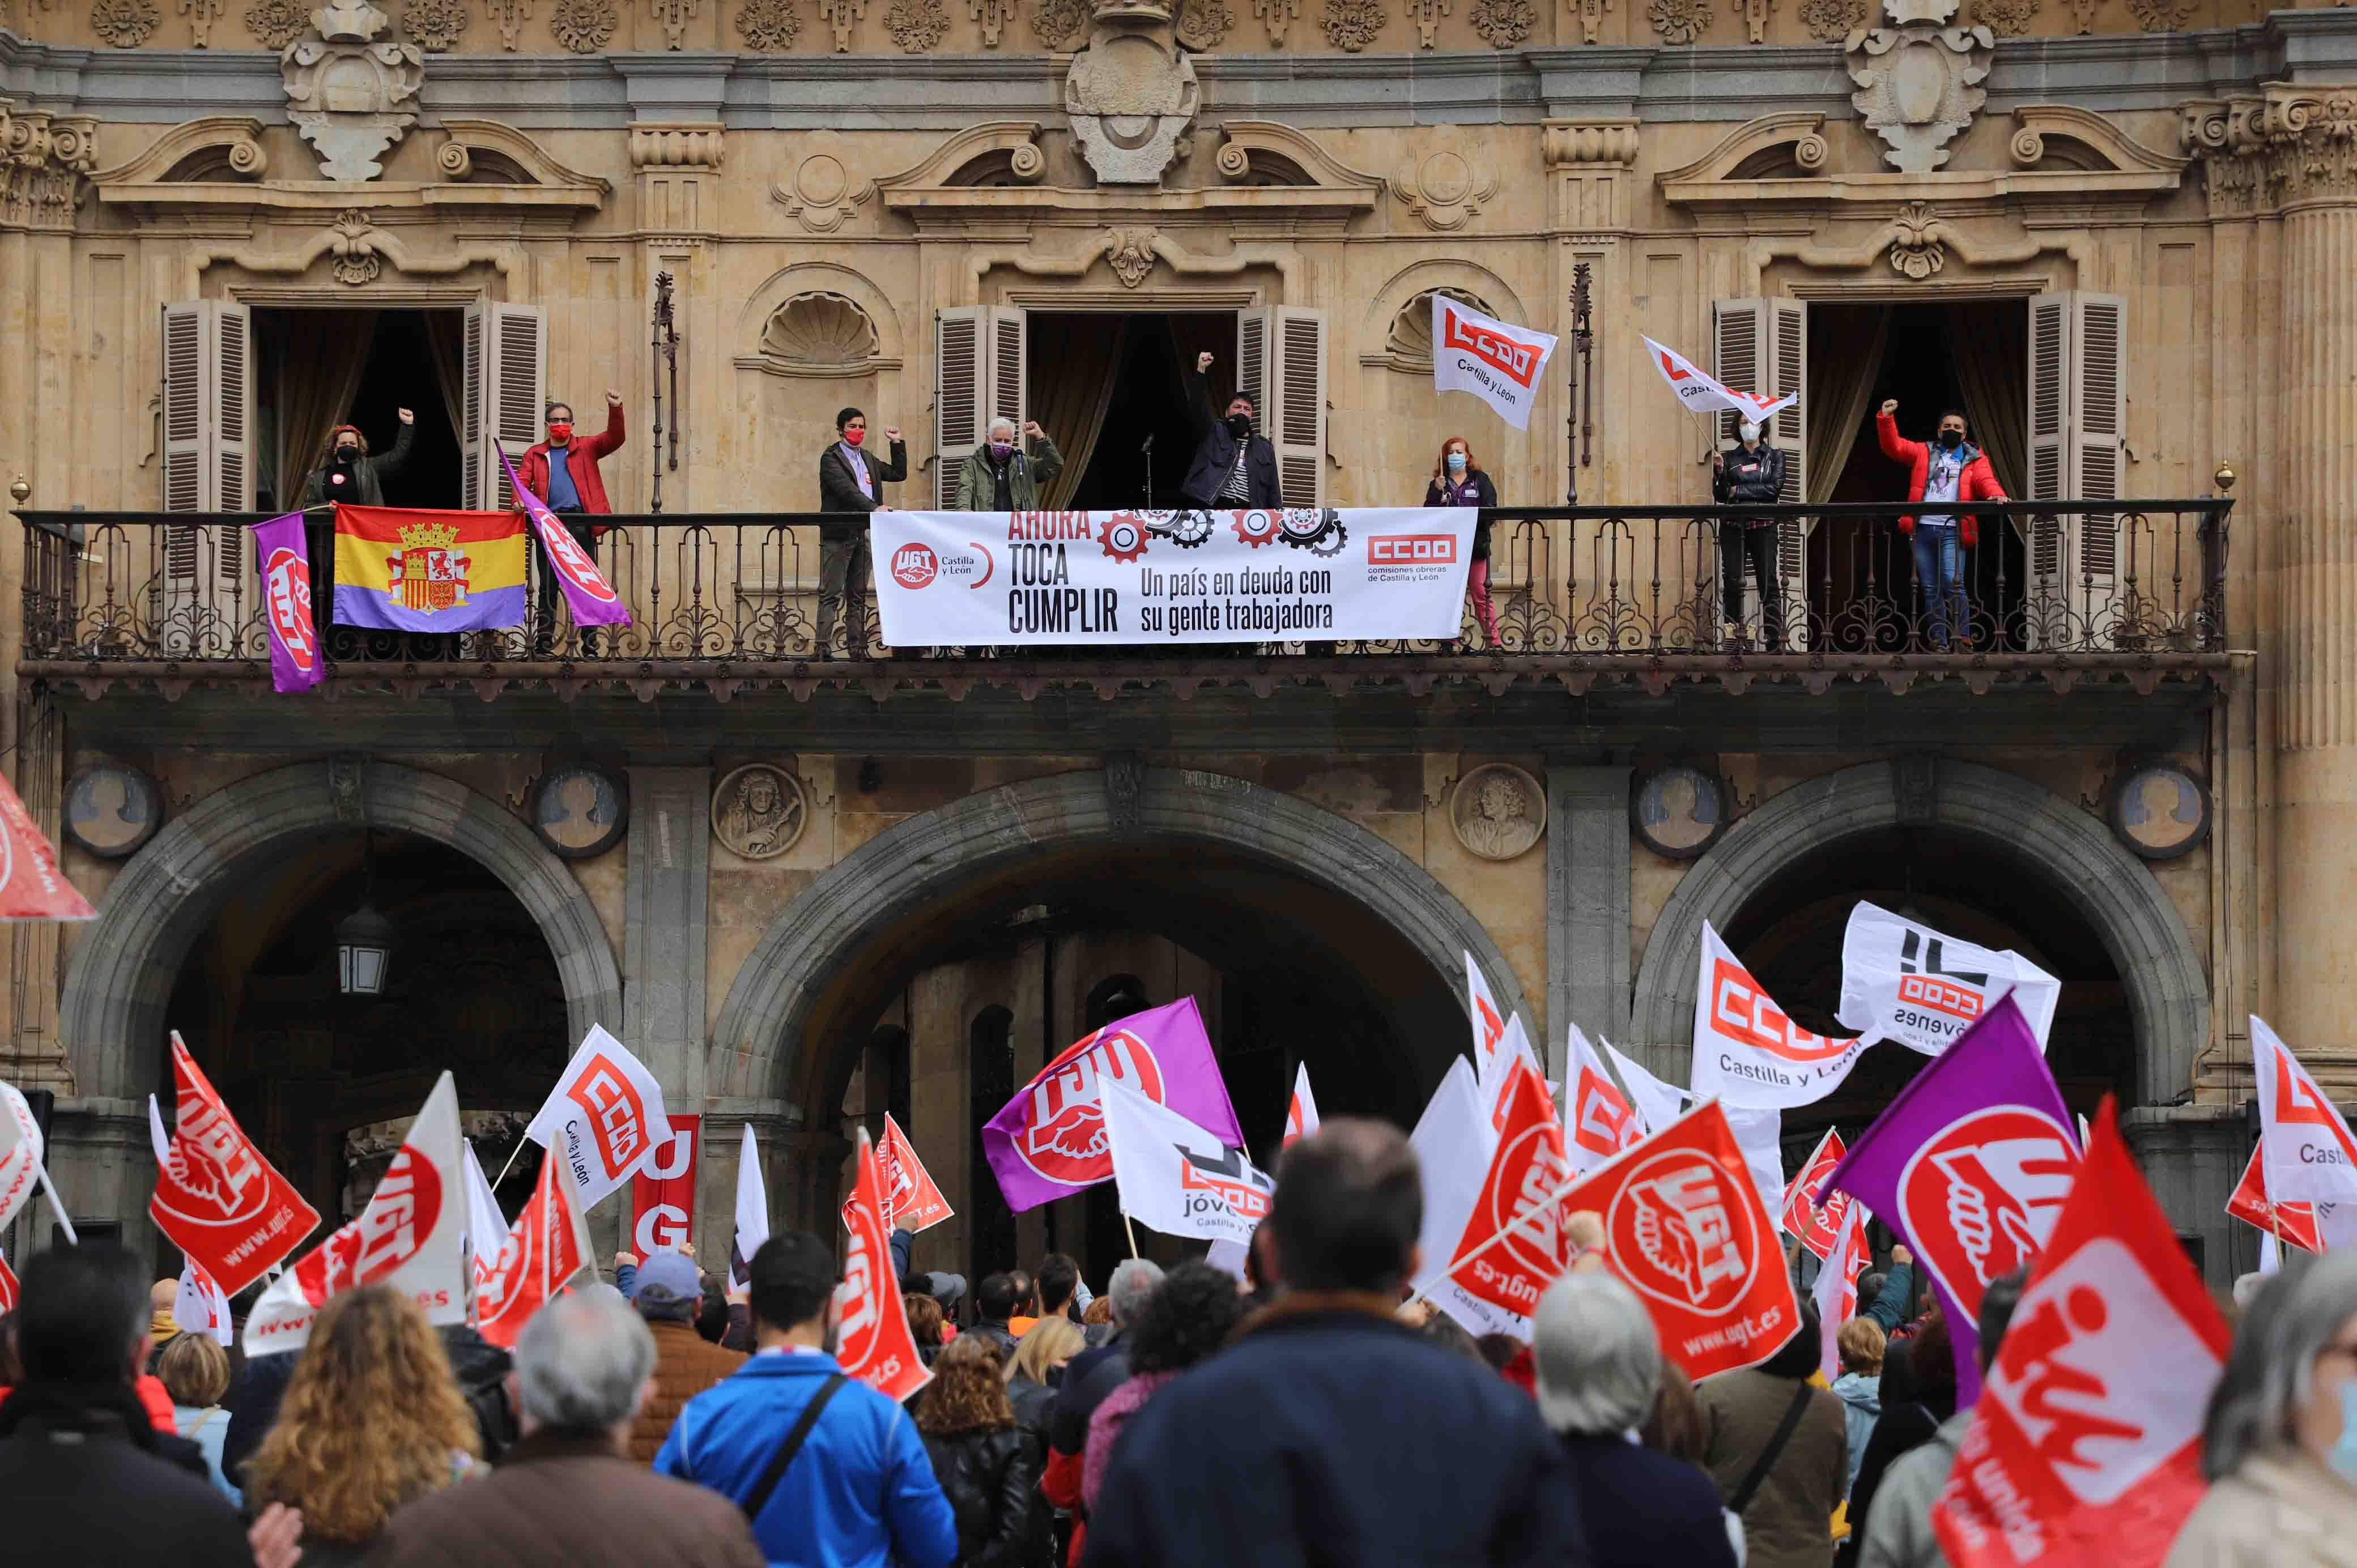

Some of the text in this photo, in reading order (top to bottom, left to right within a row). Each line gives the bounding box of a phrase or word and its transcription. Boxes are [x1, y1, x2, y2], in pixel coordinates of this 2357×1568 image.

[1454, 316, 1532, 377] CCOO
[1457, 359, 1516, 404] Catilla y León
[1008, 510, 1091, 540] AHORA
[896, 551, 931, 569] UGT
[942, 556, 974, 565] Castilla
[1009, 543, 1069, 586] TOCA
[1373, 540, 1451, 559] CCOO
[950, 566, 971, 574] León
[1141, 564, 1331, 600] Un país en deuda con
[1009, 587, 1118, 633] CUMPLIR
[1141, 598, 1333, 636] su gente trabajadora
[1717, 977, 1850, 1051] CCO
[1720, 1054, 1790, 1086] Castilla
[1797, 1073, 1809, 1086] y
[582, 1069, 639, 1168] CCOO
[176, 1097, 263, 1192] UGT
[2300, 1143, 2349, 1165] Cast
[572, 1157, 590, 1187] León
[1656, 1165, 1747, 1284] UGT
[1682, 1305, 1782, 1357] www.ugt.es
